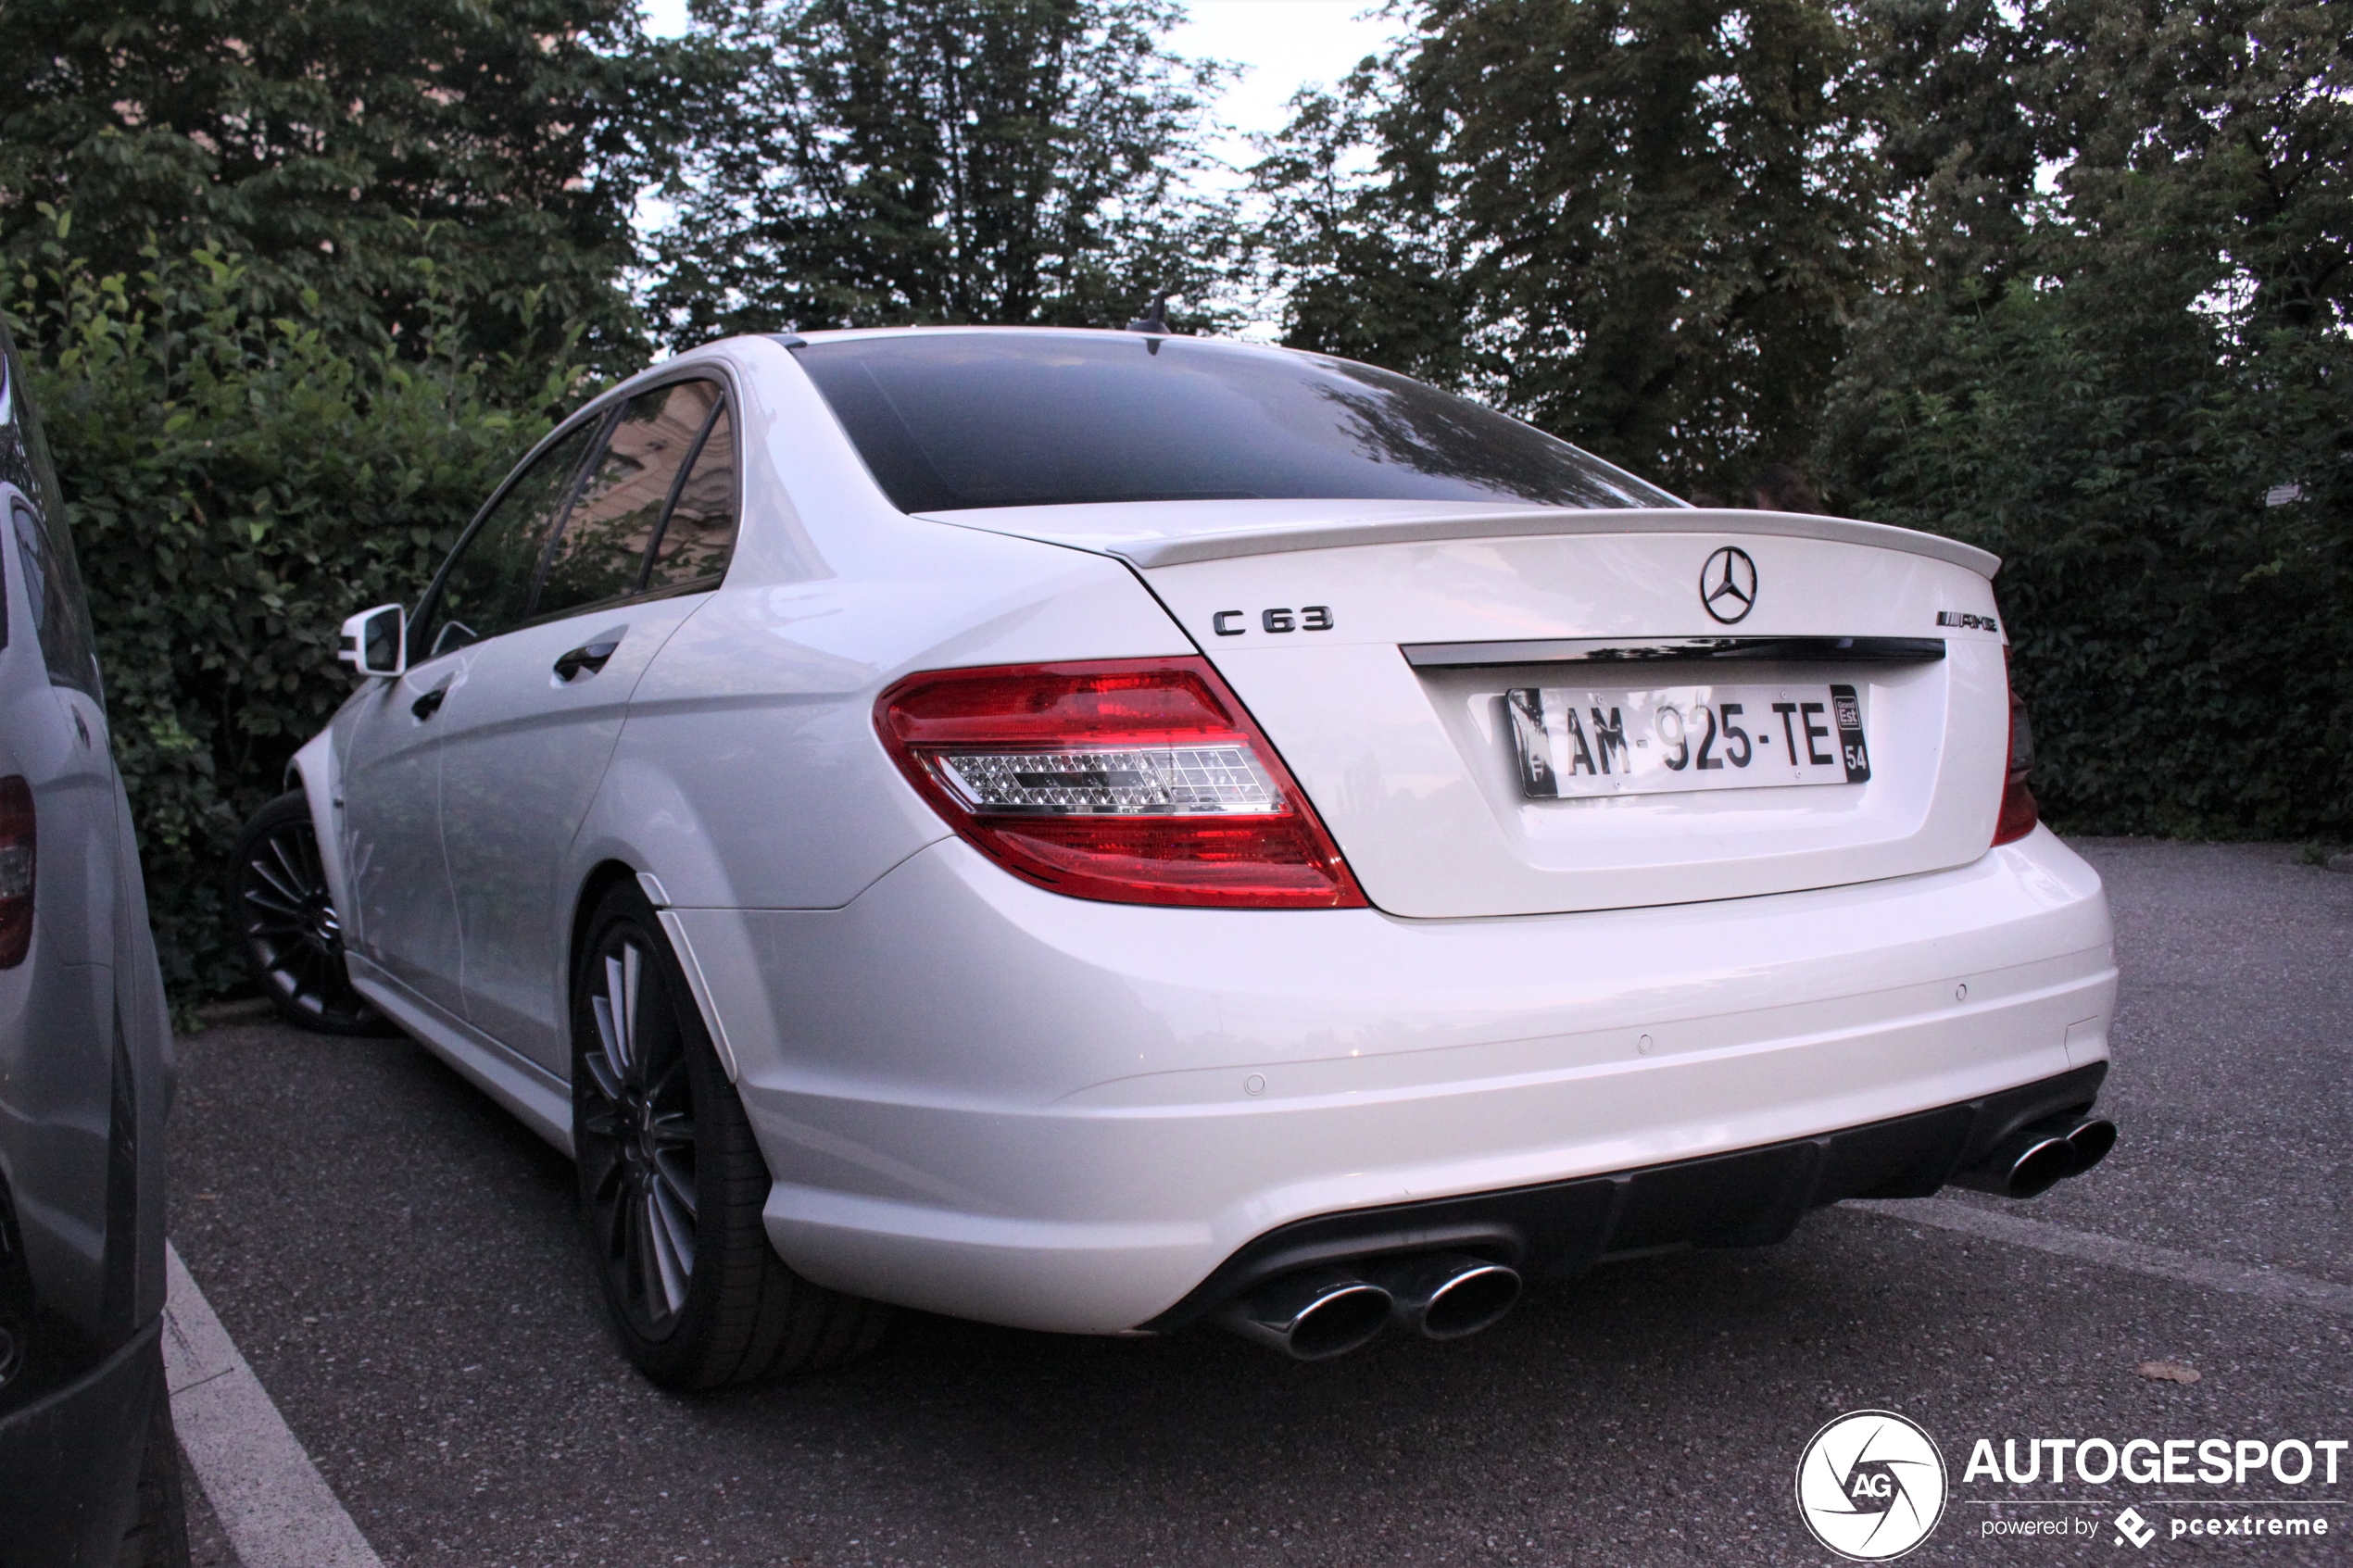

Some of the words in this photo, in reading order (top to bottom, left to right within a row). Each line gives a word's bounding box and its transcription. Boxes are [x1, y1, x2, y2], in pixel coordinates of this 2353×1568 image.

[1213, 609, 1246, 636] C
[1262, 606, 1334, 633] 63
[1839, 709, 1857, 722] Est
[1567, 702, 1834, 776] AM-925-TE
[1844, 745, 1867, 770] 54
[1530, 759, 1543, 782] F
